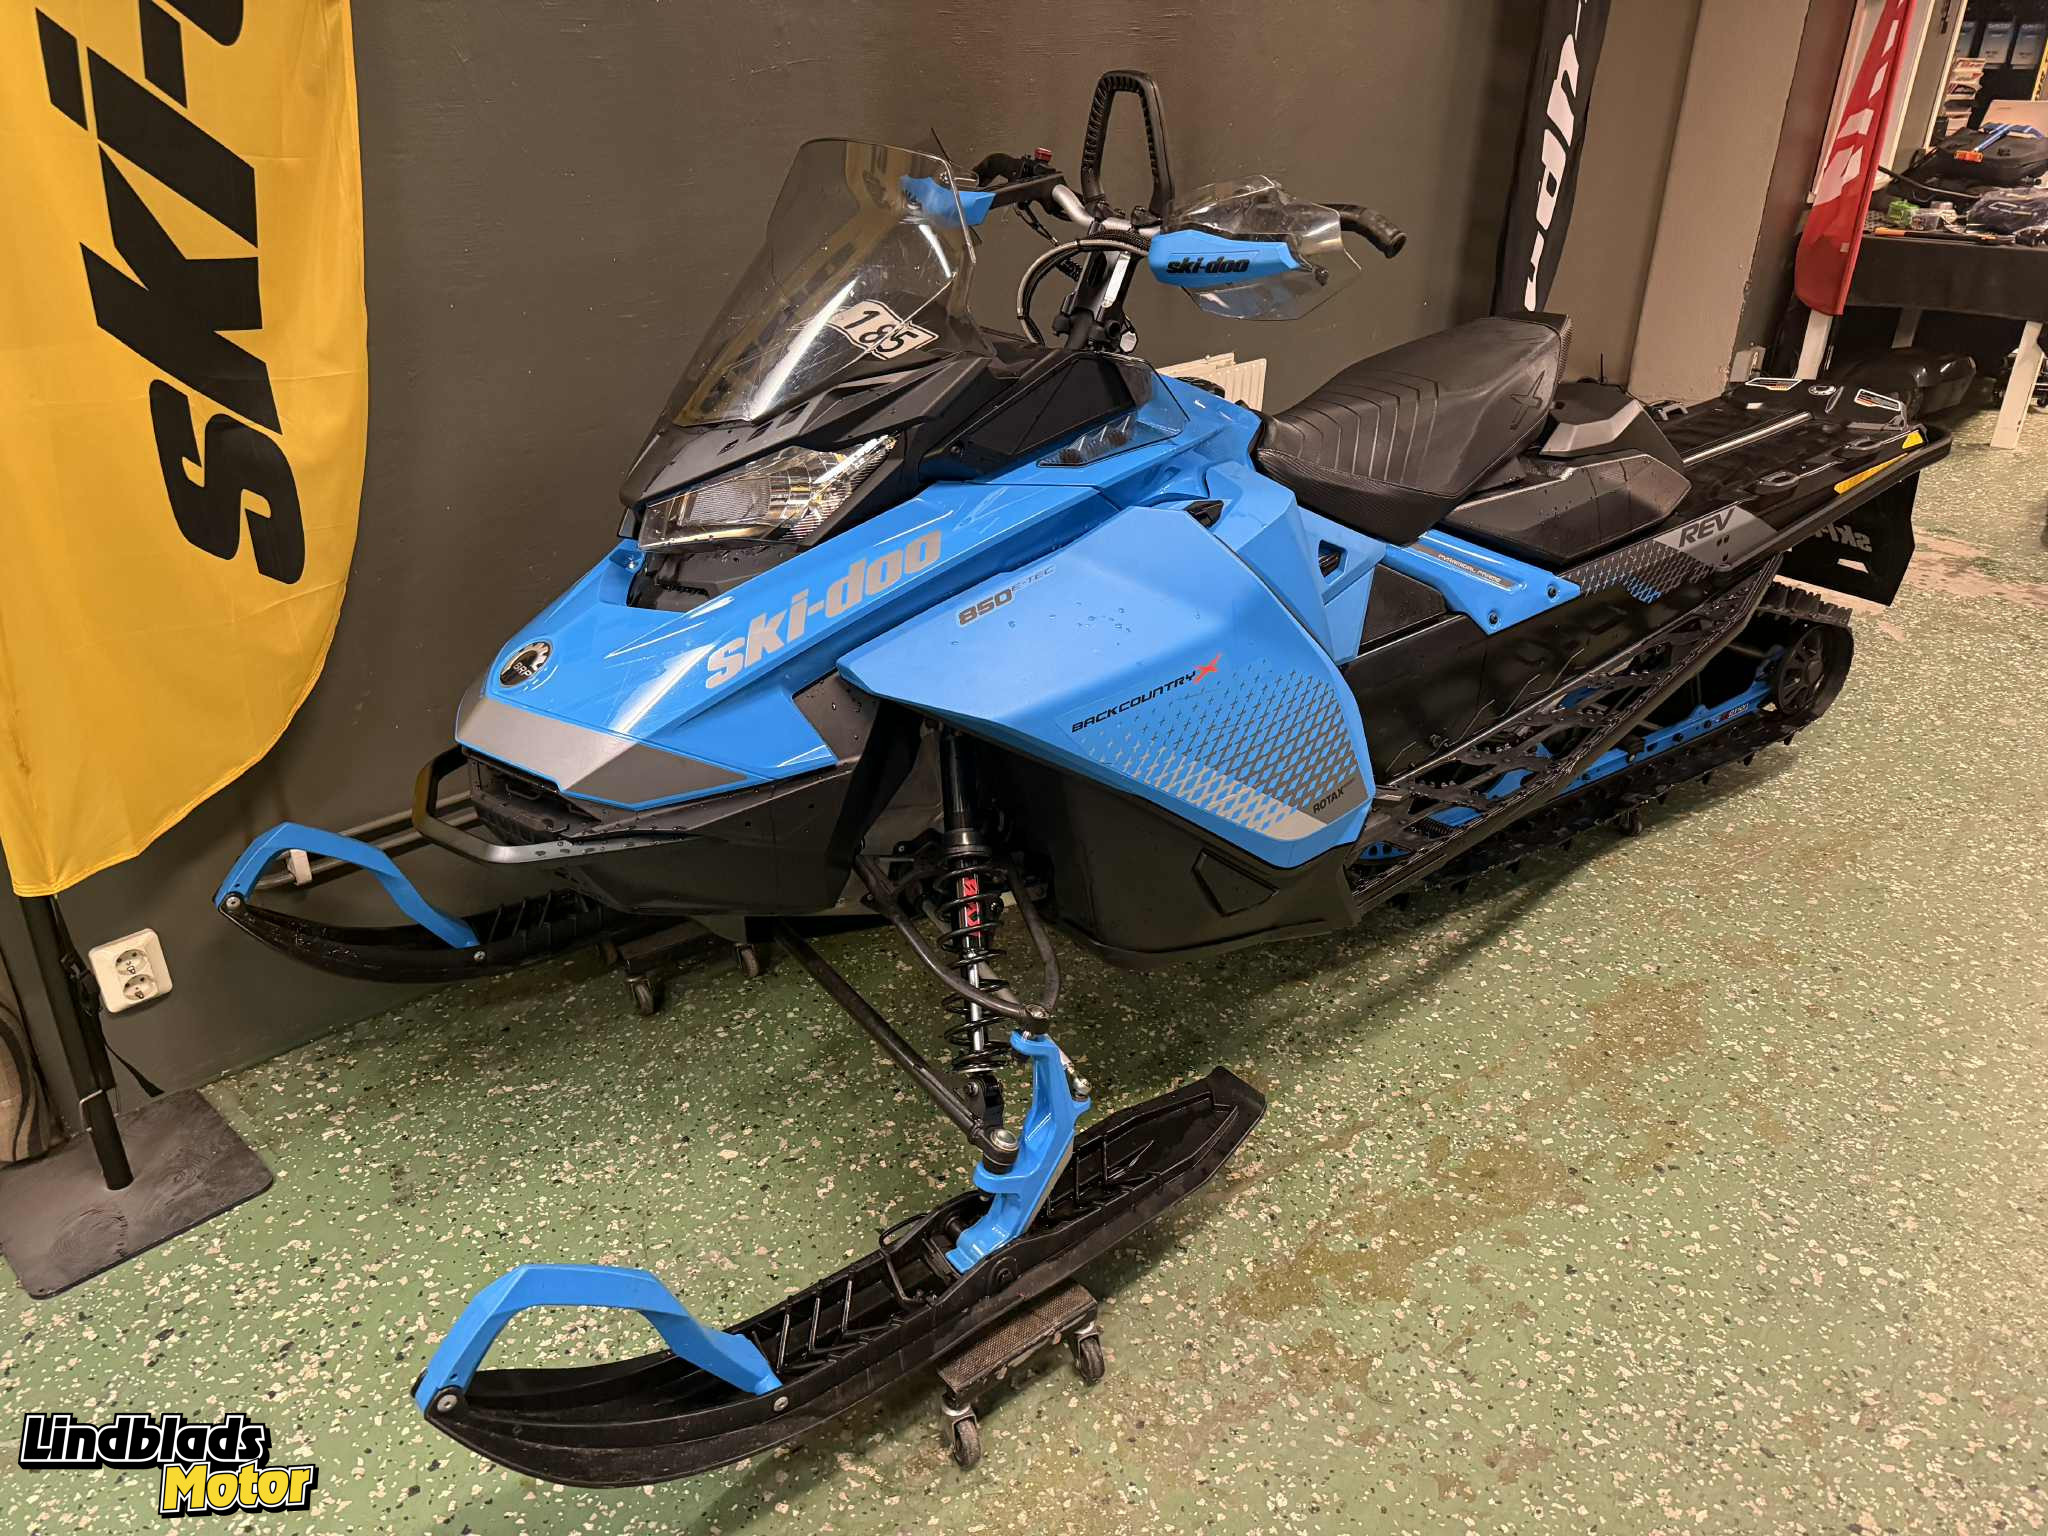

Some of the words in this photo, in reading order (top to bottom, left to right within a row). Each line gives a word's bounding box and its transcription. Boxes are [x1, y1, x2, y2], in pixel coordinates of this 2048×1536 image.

[1166, 256, 1250, 274] ski-doo
[844, 310, 919, 352] 185
[1679, 508, 1735, 547] REV
[706, 530, 943, 689] ski-doo
[959, 588, 1012, 625] 850
[513, 662, 532, 676] BRP
[1071, 670, 1196, 733] BACKCOUNTRY
[1313, 786, 1344, 814] ROTAX
